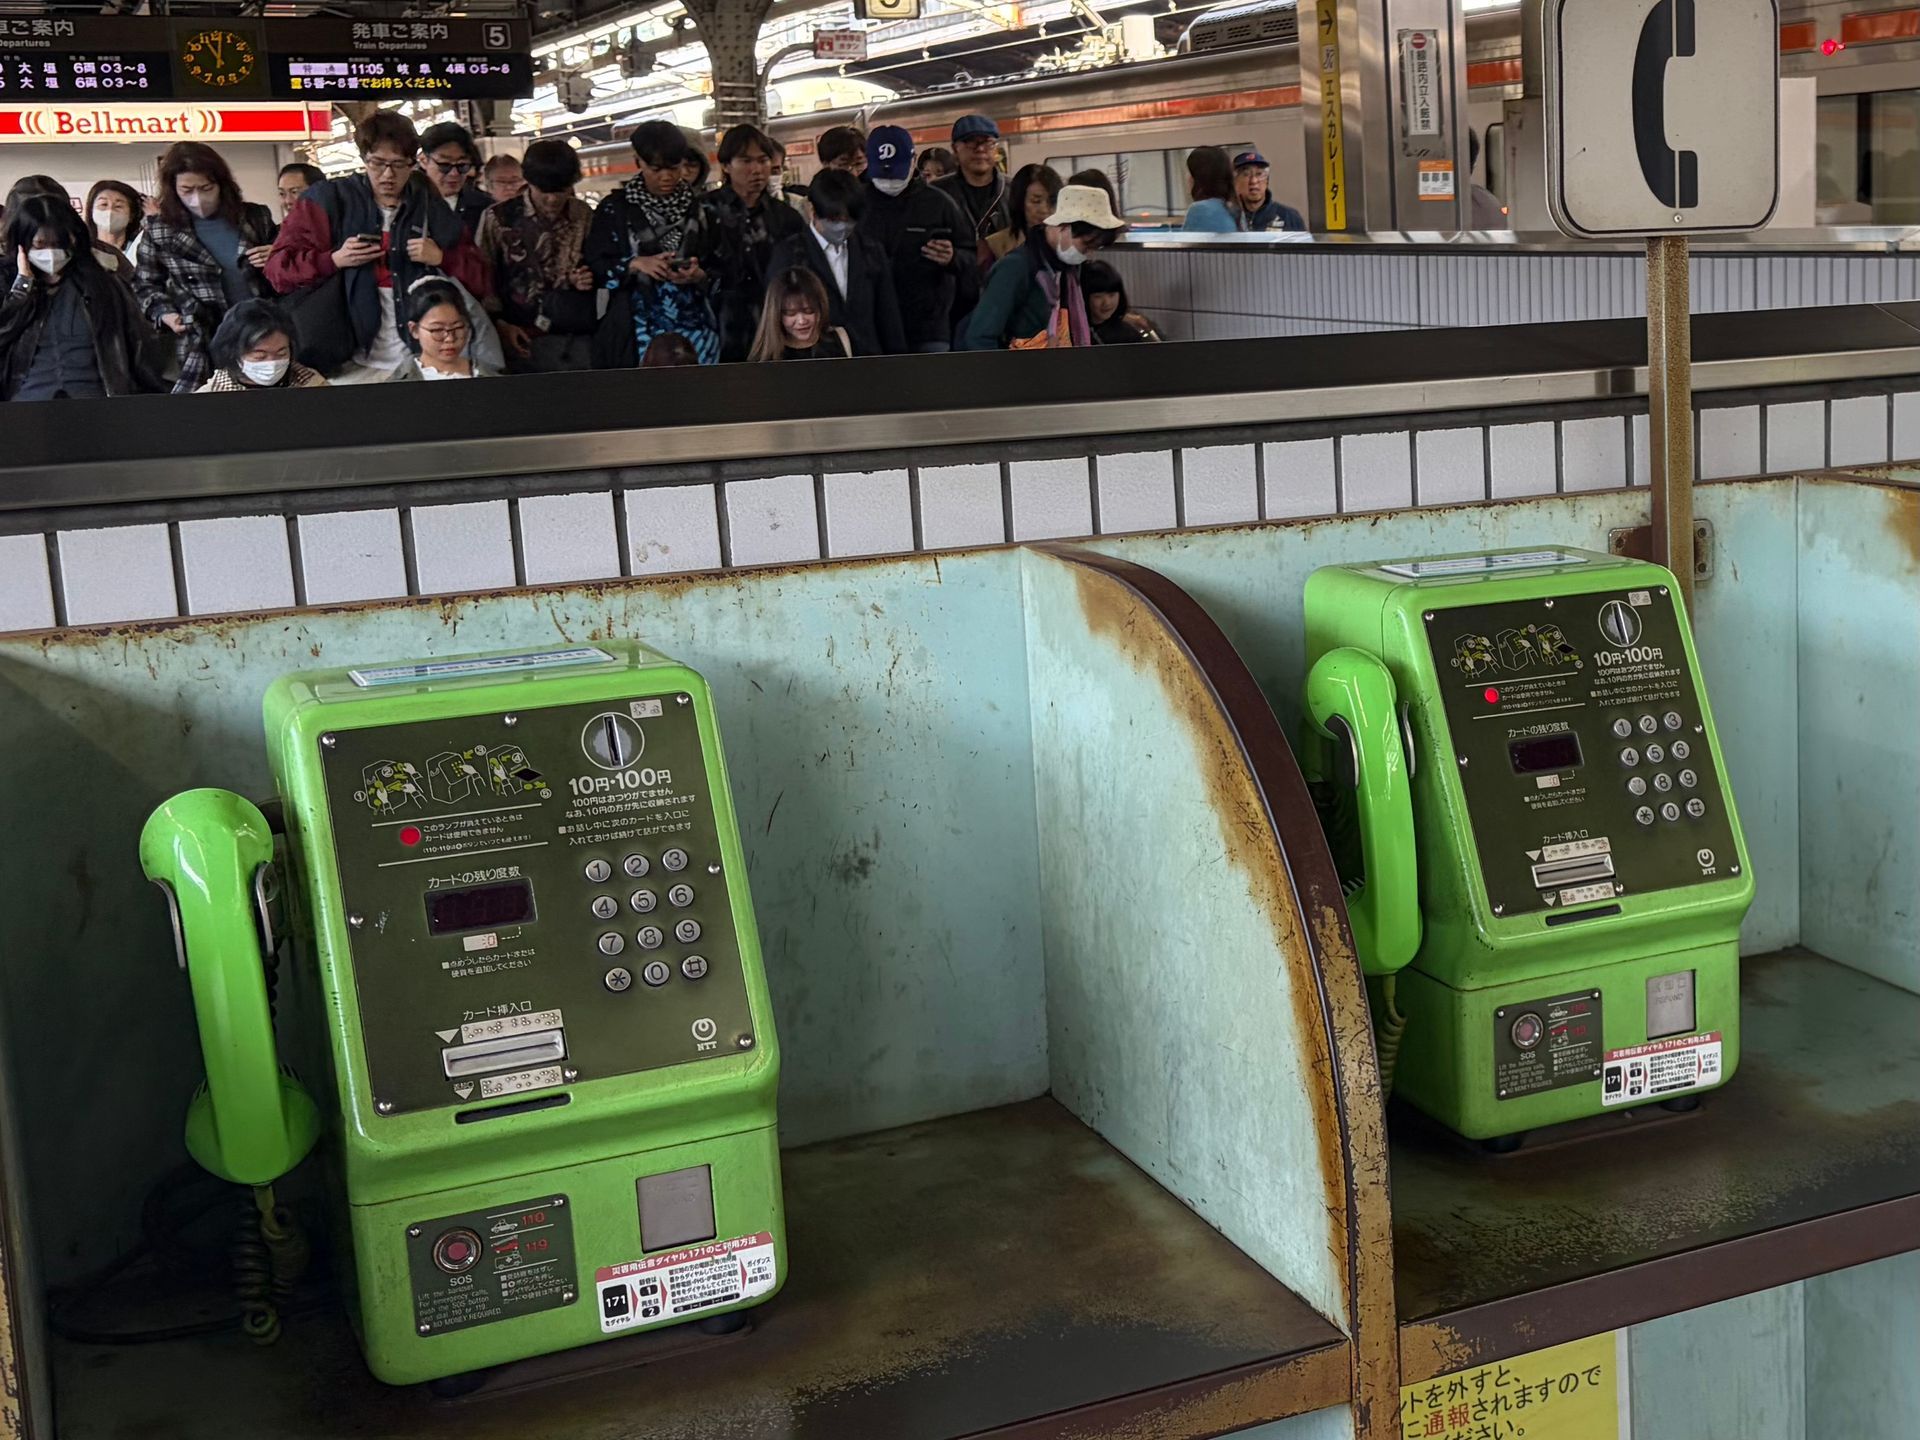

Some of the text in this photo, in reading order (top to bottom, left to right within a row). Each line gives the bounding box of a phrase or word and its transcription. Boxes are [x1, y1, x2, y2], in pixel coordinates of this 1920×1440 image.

[352, 22, 449, 39] 発車ご案内
[488, 26, 505, 47] 5
[353, 41, 428, 51] Train Departures
[351, 64, 385, 75] 11:05
[54, 111, 191, 134] Bellmart
[878, 143, 897, 160] D
[1326, 79, 1339, 222] エスカレーター
[1507, 721, 1570, 738] カードの残り度数
[1619, 714, 1678, 734] 1 2 3
[1626, 743, 1686, 763] 4 5 6
[1659, 775, 1668, 789] 8
[1684, 772, 1693, 785] 9
[565, 794, 696, 819] なお、10円の方が先に収納されます
[572, 787, 674, 808] 100円はおつりがでません
[1666, 804, 1676, 818] 0
[423, 814, 524, 833] このランプが消えているときは
[425, 826, 504, 842] カードは使用できません
[569, 822, 692, 847] 入れておけば続けて話ができます
[1542, 829, 1589, 844] カード挿入口
[593, 851, 681, 880] 1 2 3
[428, 865, 521, 889] カードの残り度数
[599, 887, 687, 915] 4 5 6
[605, 922, 695, 952] 7 8 9
[650, 964, 663, 980] 0
[463, 1000, 533, 1021] カード挿入口
[697, 1041, 718, 1051] NTT
[1520, 1050, 1536, 1060] SOS
[1606, 1075, 1620, 1085] 171
[611, 1236, 757, 1276] 災害用伝言ダイヤル171のご利用方法
[449, 1274, 473, 1287] SOS
[605, 1294, 626, 1308] 171
[605, 1316, 631, 1327] をダイヤル
[1400, 1364, 1602, 1440] に通報されますので
